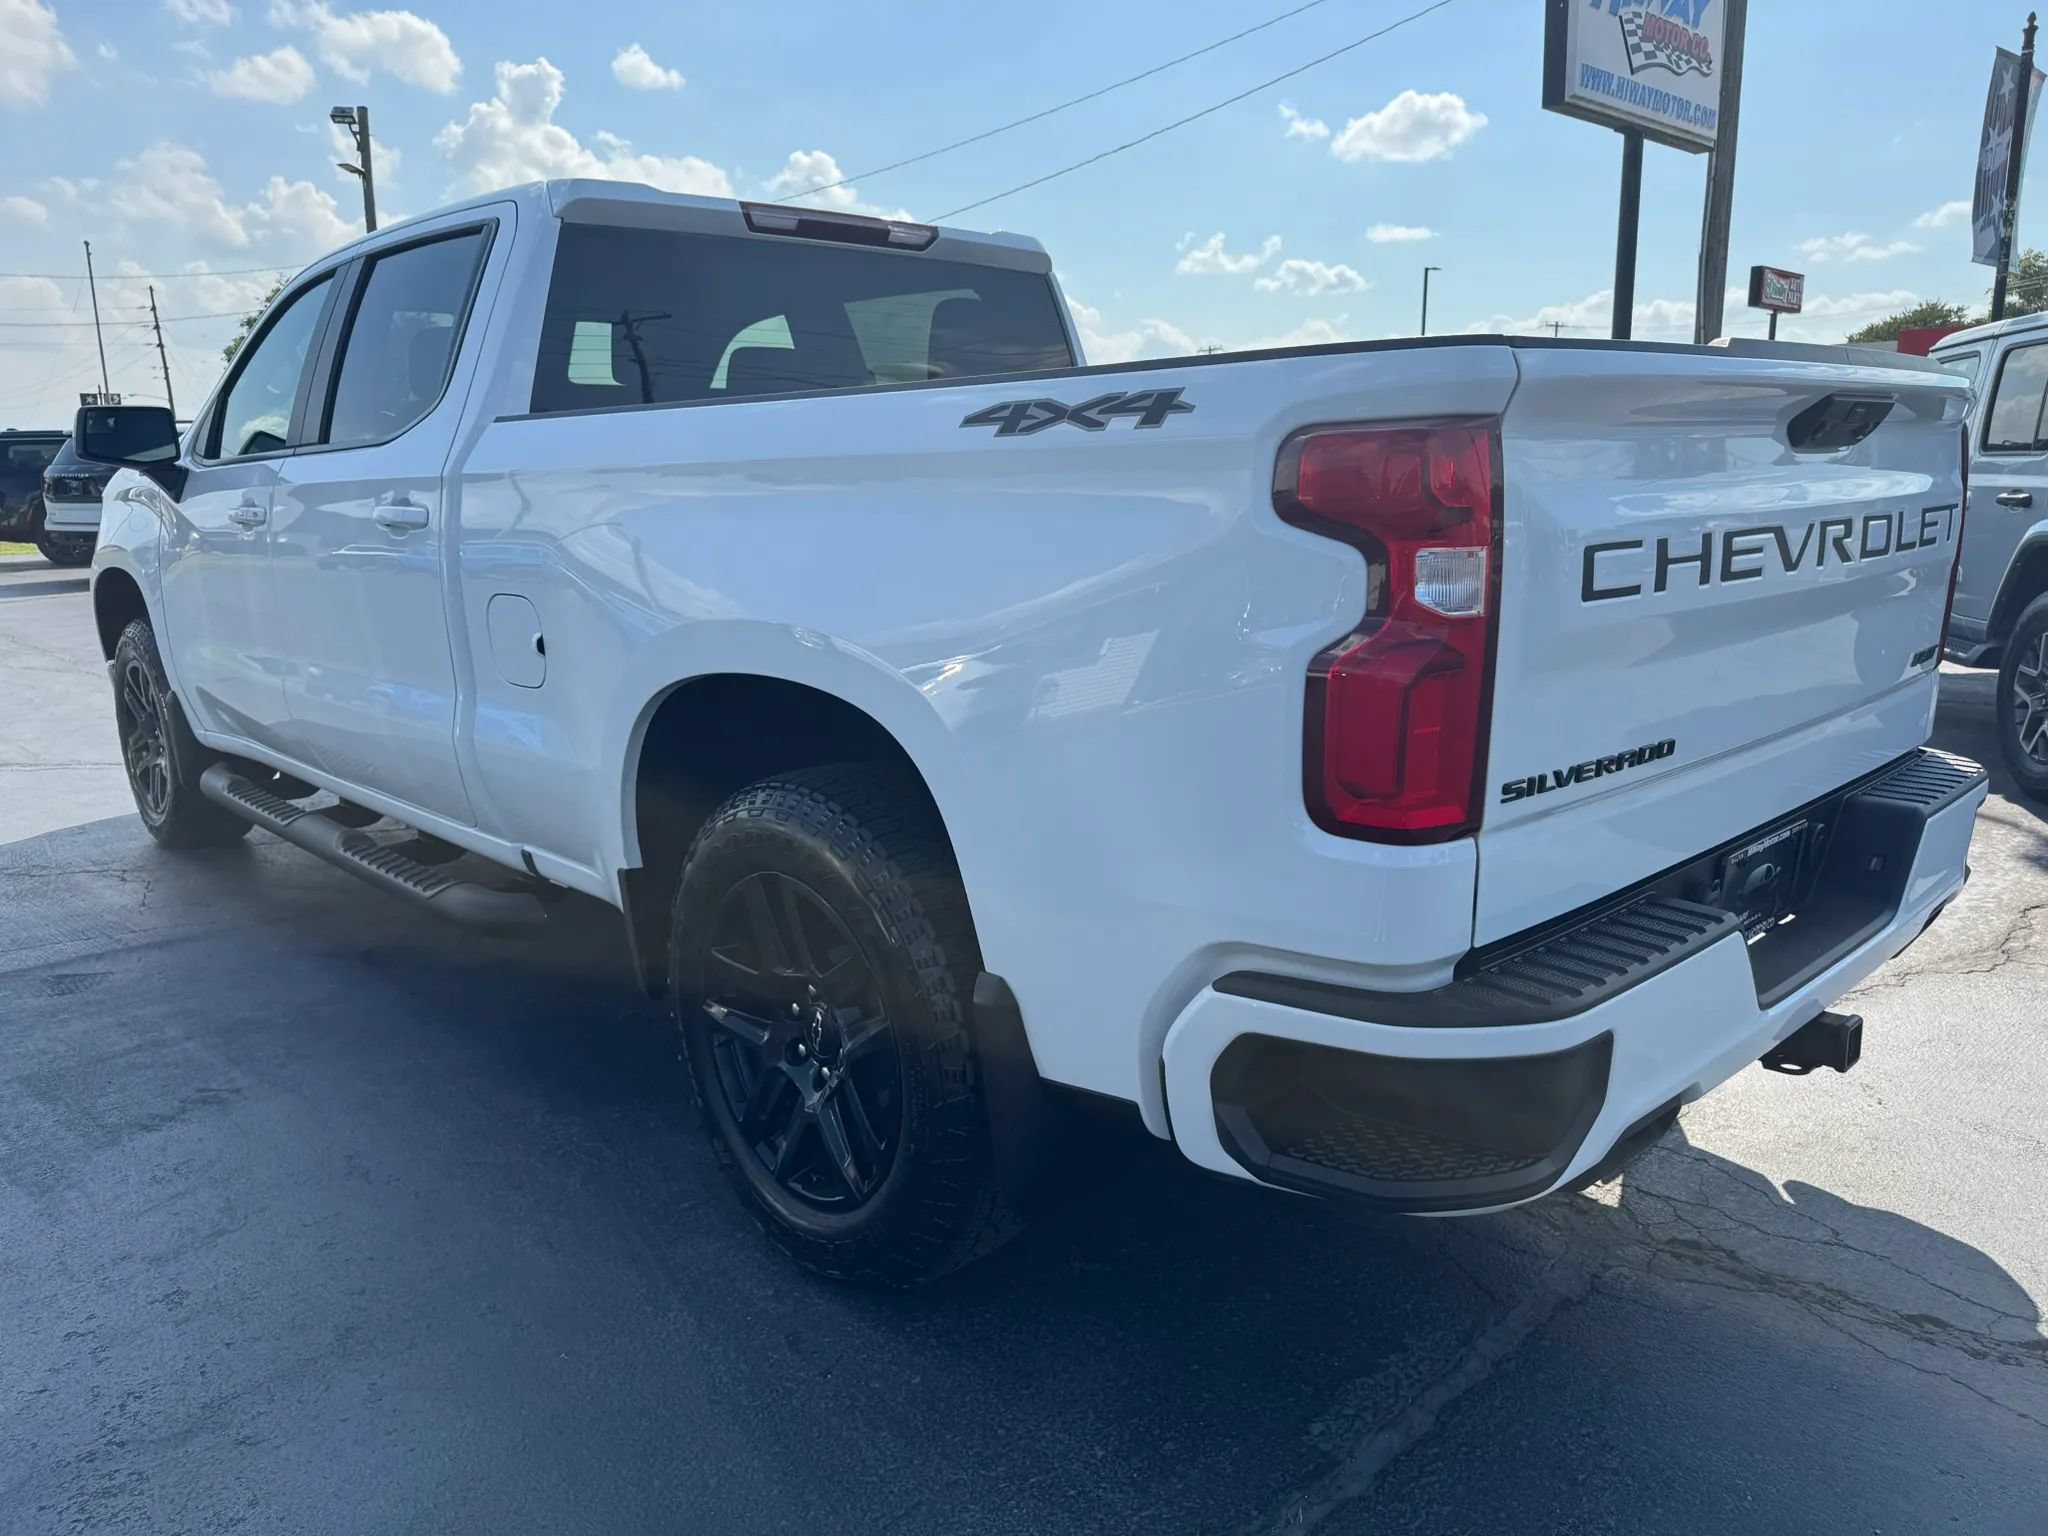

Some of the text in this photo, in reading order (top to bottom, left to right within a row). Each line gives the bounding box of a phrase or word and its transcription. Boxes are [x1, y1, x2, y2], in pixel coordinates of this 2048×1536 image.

[1642, 11, 1691, 51] MOTOR
[1580, 62, 1717, 130] WWW.HIWAYMOTOR.COM
[1581, 503, 1959, 602] CHEVROLET
[1500, 738, 1676, 804] SILVERADO
